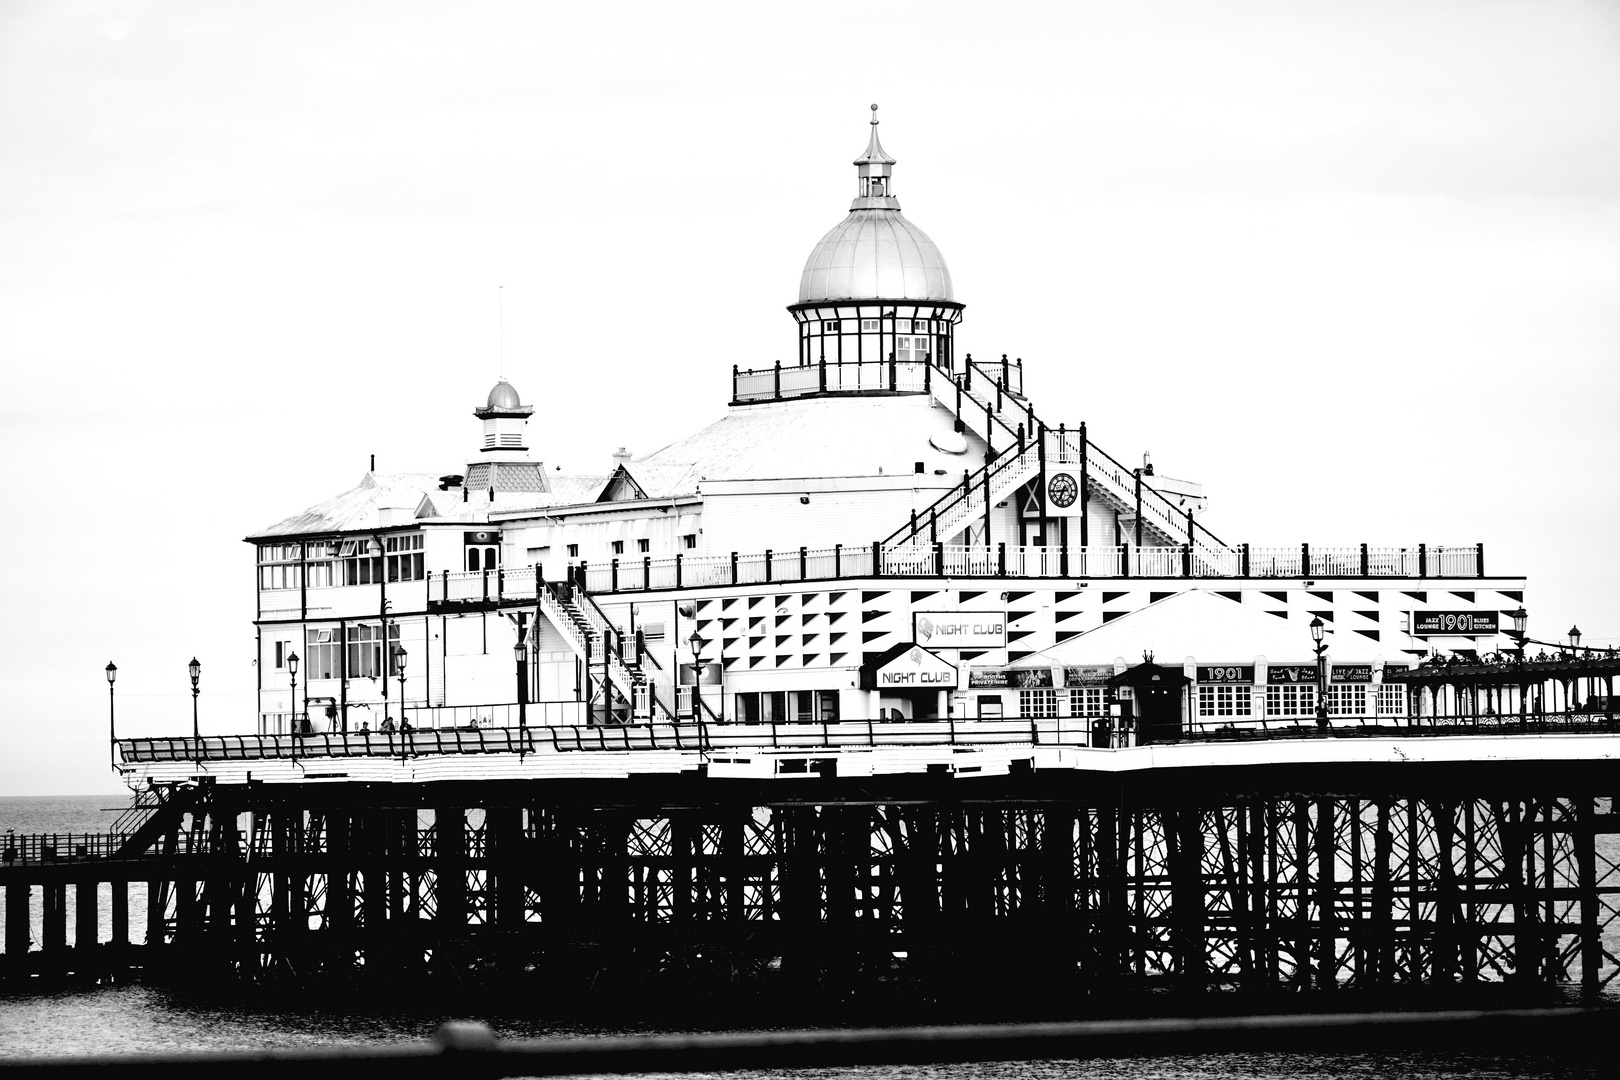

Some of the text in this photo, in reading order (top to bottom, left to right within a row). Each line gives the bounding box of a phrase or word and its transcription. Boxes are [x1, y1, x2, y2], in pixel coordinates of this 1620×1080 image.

[1438, 614, 1472, 630] 1901
[936, 624, 1003, 635] NIGHT CLUB
[882, 672, 951, 683] NIGHT CLUB
[1207, 668, 1242, 679] 1901
